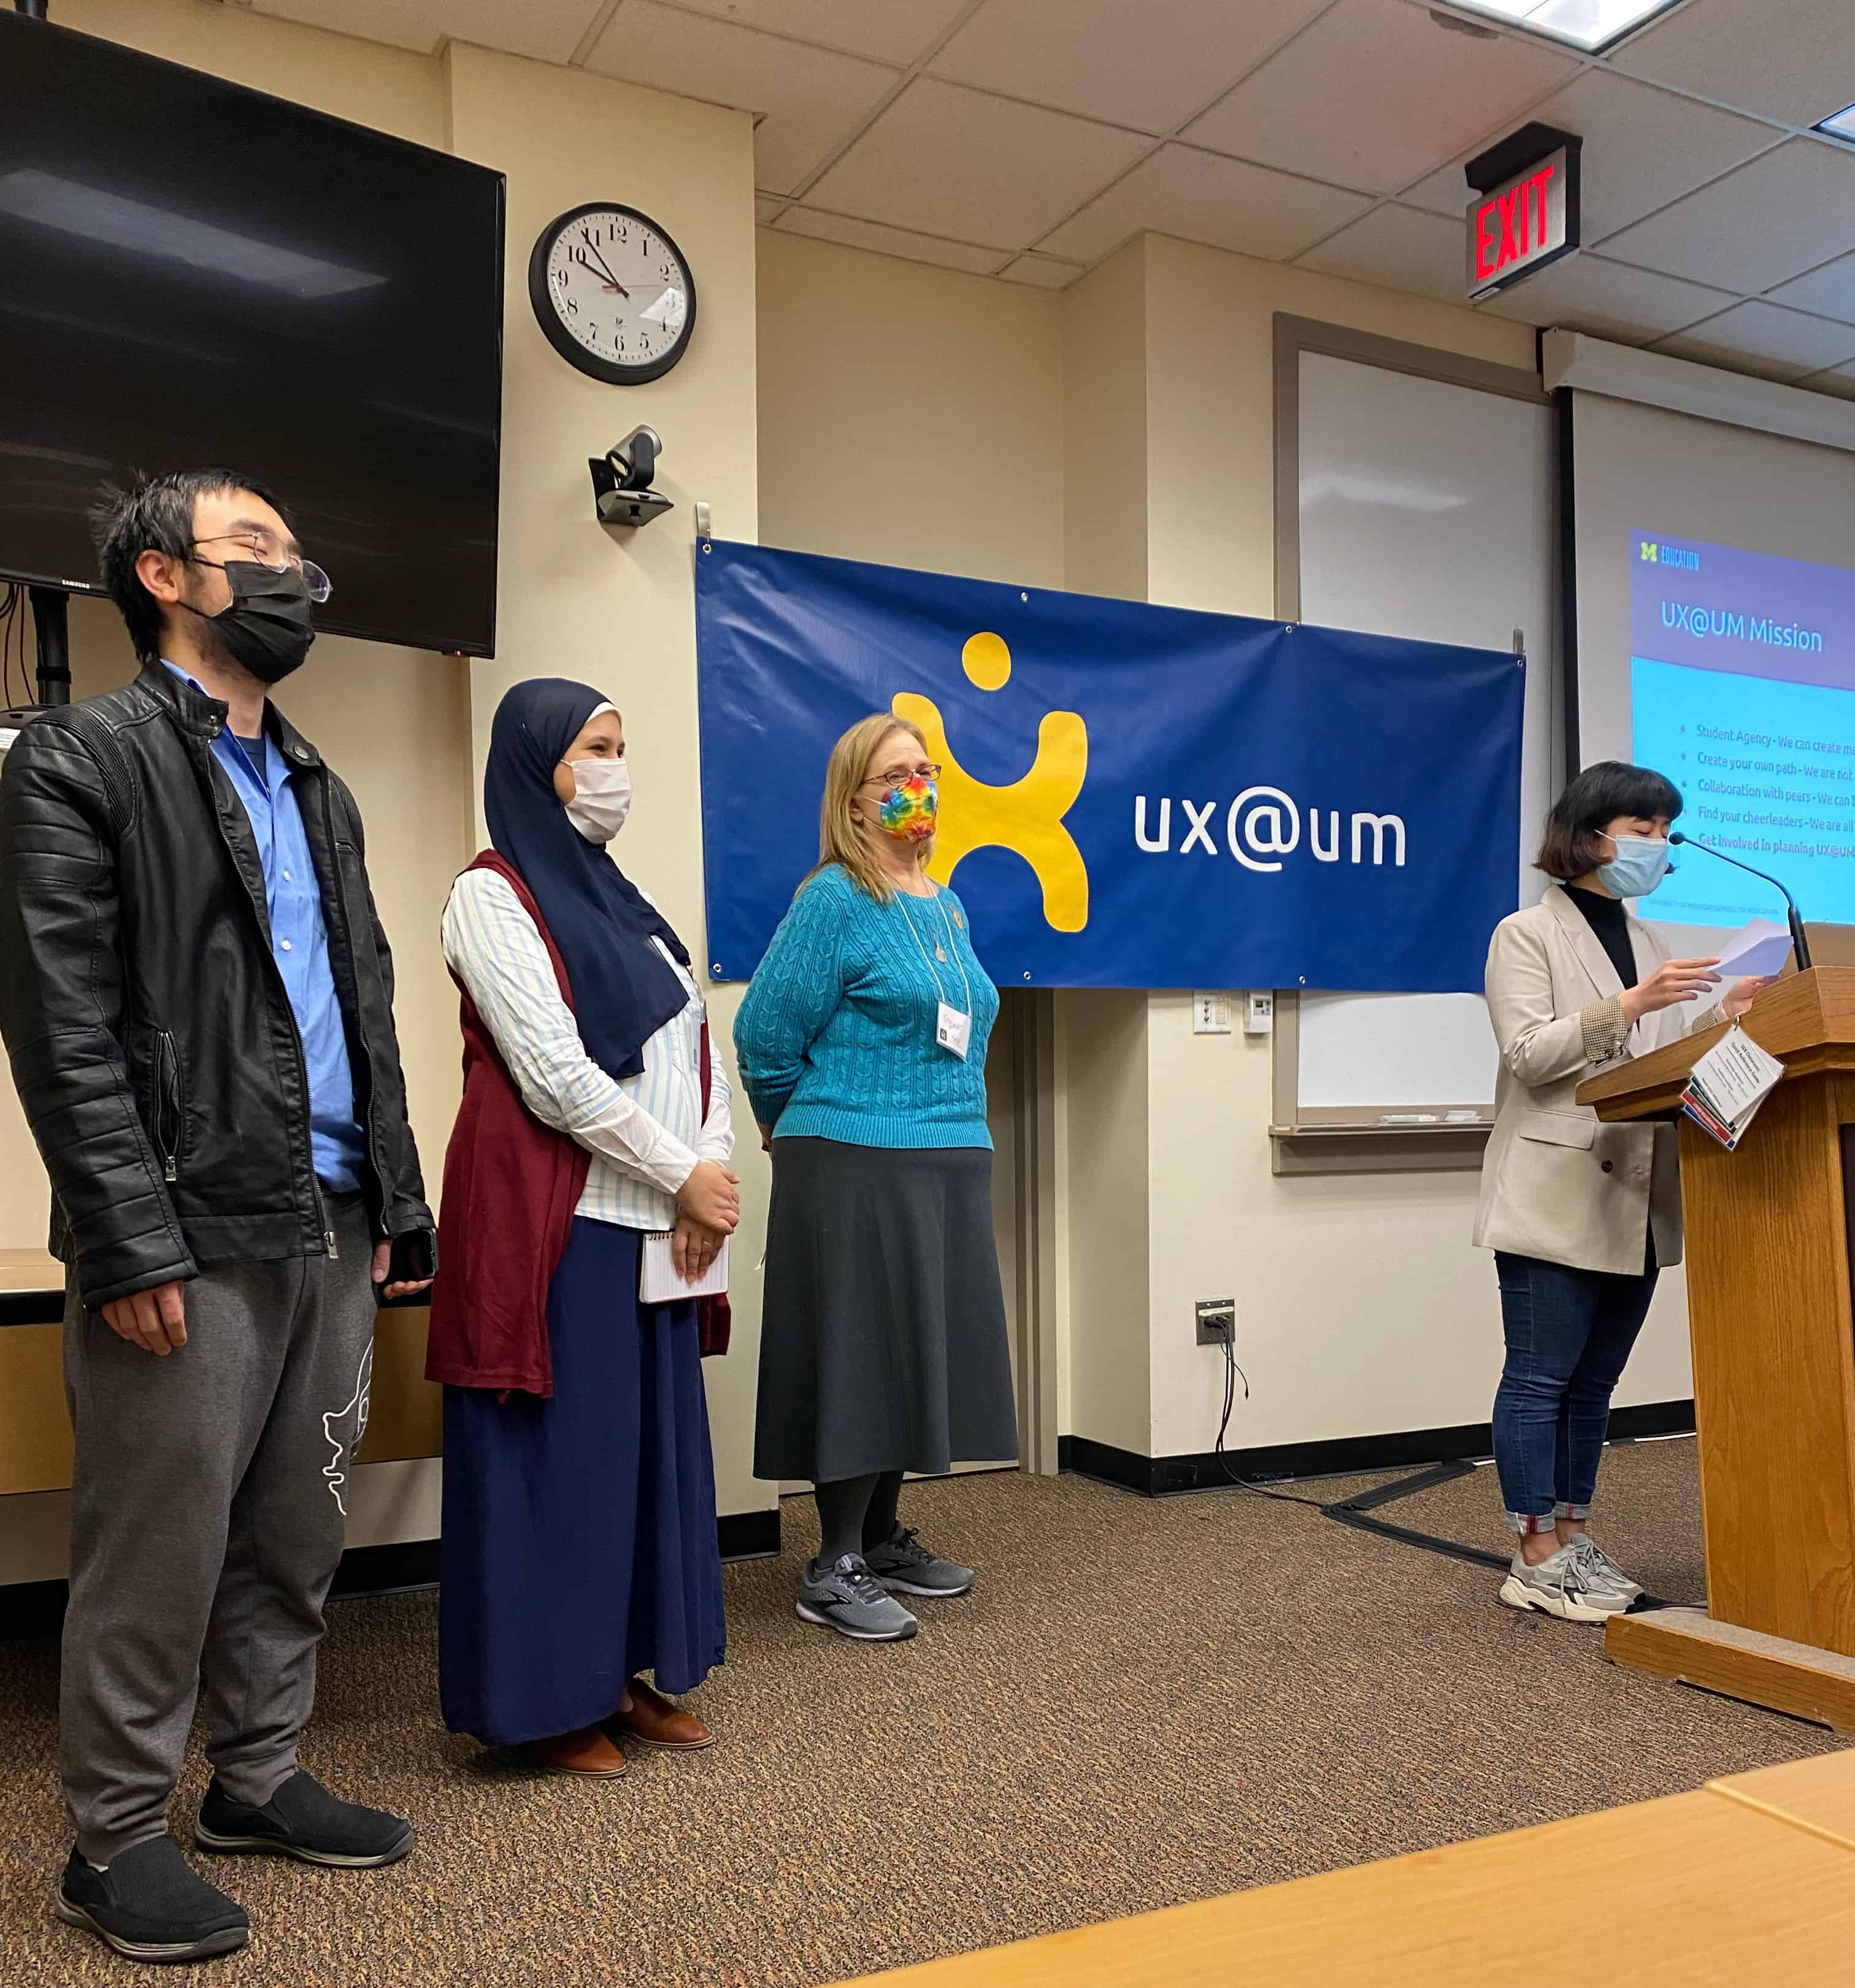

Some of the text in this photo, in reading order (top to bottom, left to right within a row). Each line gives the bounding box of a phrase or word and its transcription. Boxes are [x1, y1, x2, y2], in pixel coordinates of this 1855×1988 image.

[1477, 166, 1554, 282] EXIT
[583, 228, 601, 246] 11
[609, 224, 627, 243] 12
[568, 245, 586, 263] 10
[642, 239, 648, 256] 1
[559, 269, 568, 286] 9
[659, 265, 669, 282] 2
[567, 297, 578, 314] 8
[590, 322, 599, 339] 7
[659, 315, 667, 331] 4
[615, 335, 624, 351] 6
[640, 332, 649, 349] 5
[1641, 542, 1700, 572] M EDUCATION
[62, 579, 90, 589] SAMSUNG
[1661, 601, 1822, 652] UX@UM Mission
[1697, 724, 1735, 741] Student
[1737, 731, 1771, 747] Agency
[1778, 735, 1792, 748] We
[1795, 740, 1811, 750] can
[1813, 742, 1841, 754] create
[1697, 751, 1728, 767] Create
[1729, 759, 1751, 770] your
[1754, 761, 1774, 771] own
[1776, 762, 1796, 776] path
[1804, 764, 1819, 777] We
[1820, 769, 1835, 779] are
[1837, 770, 1853, 781] not
[1698, 778, 1761, 798] Collaboration
[1763, 786, 1783, 800] with
[1786, 791, 1811, 803] peers
[1817, 792, 1832, 805] We
[1835, 796, 1849, 806] can
[1699, 806, 1718, 819] Find
[1720, 811, 1741, 823] your
[1743, 810, 1802, 828] cheerleaders
[1809, 817, 1824, 829] We
[1827, 821, 1840, 831] are
[1843, 819, 1854, 832] all
[1134, 785, 1406, 872] ux@um
[1699, 833, 1717, 846] Get
[1718, 834, 1759, 850] involved
[1773, 839, 1815, 858] planning
